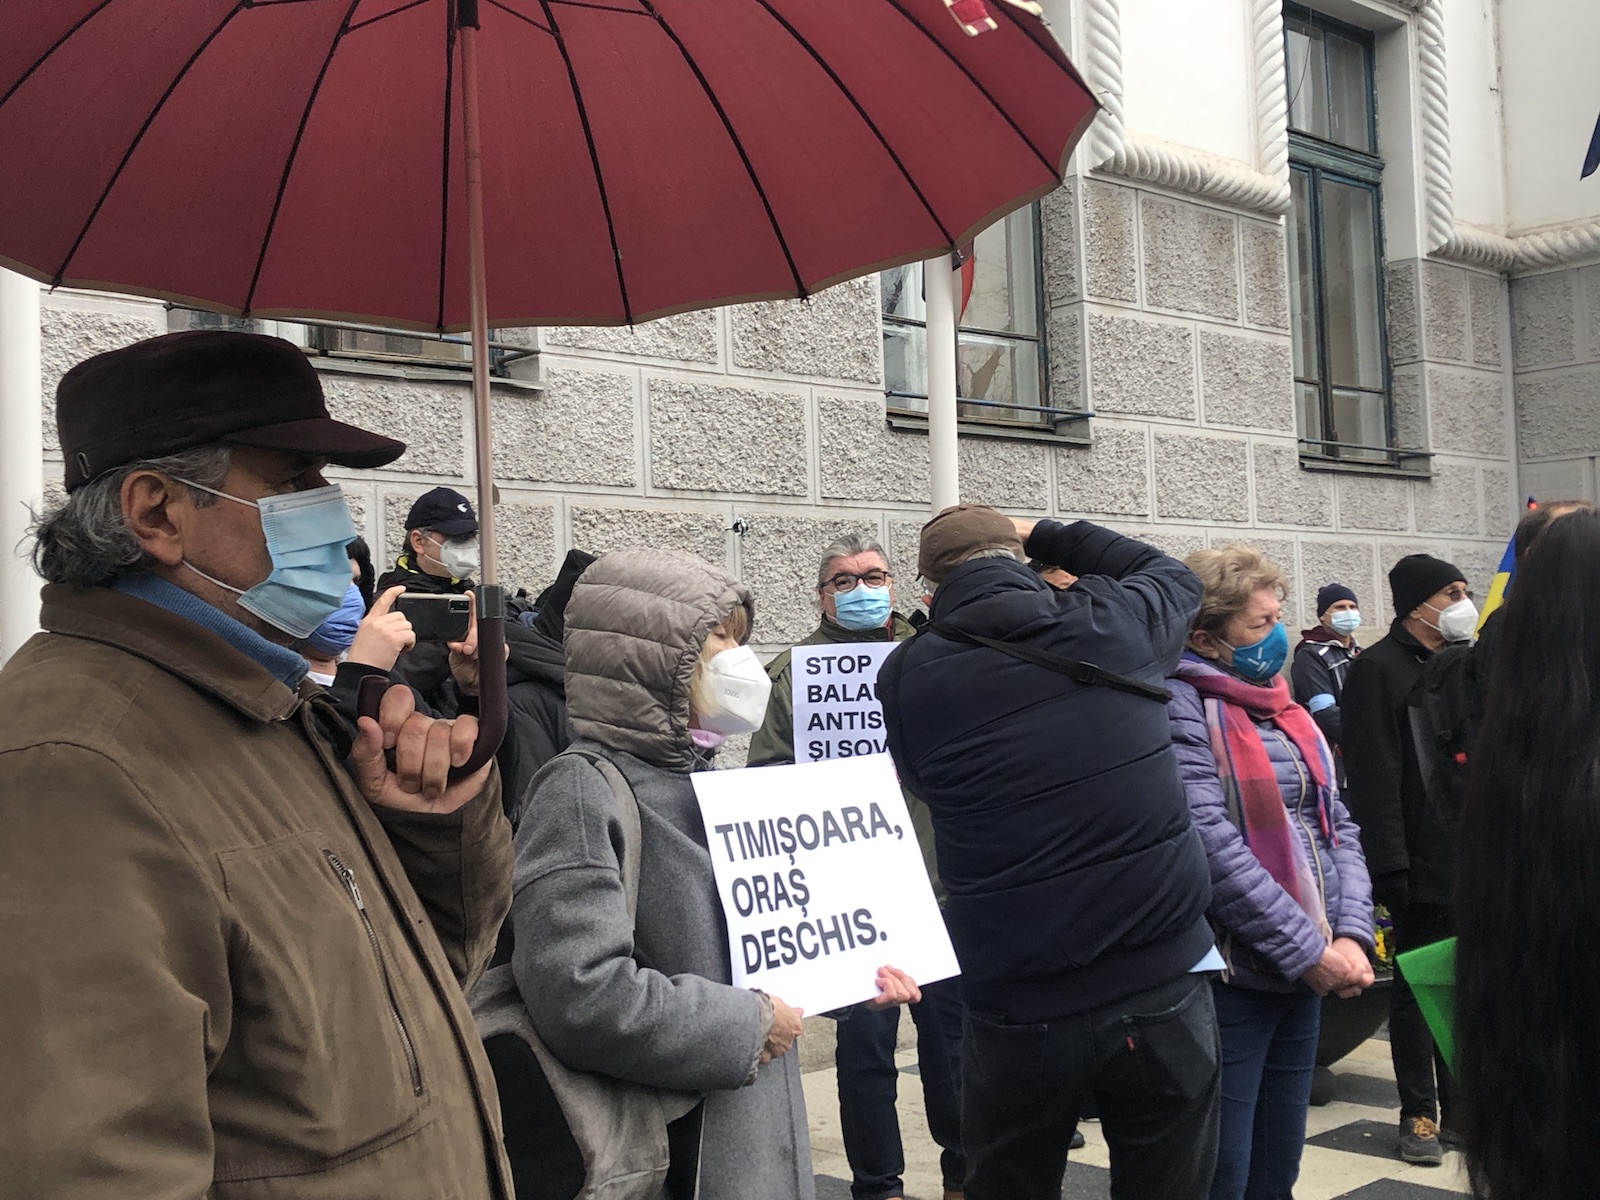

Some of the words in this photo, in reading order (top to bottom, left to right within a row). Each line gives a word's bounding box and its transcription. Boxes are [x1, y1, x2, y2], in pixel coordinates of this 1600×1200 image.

[806, 655, 872, 675] STOP
[808, 740, 831, 762] ȘI
[715, 802, 903, 865] TIMIȘOARA,
[731, 868, 810, 917] ORAȘ
[741, 908, 887, 975] DESCHIS.
